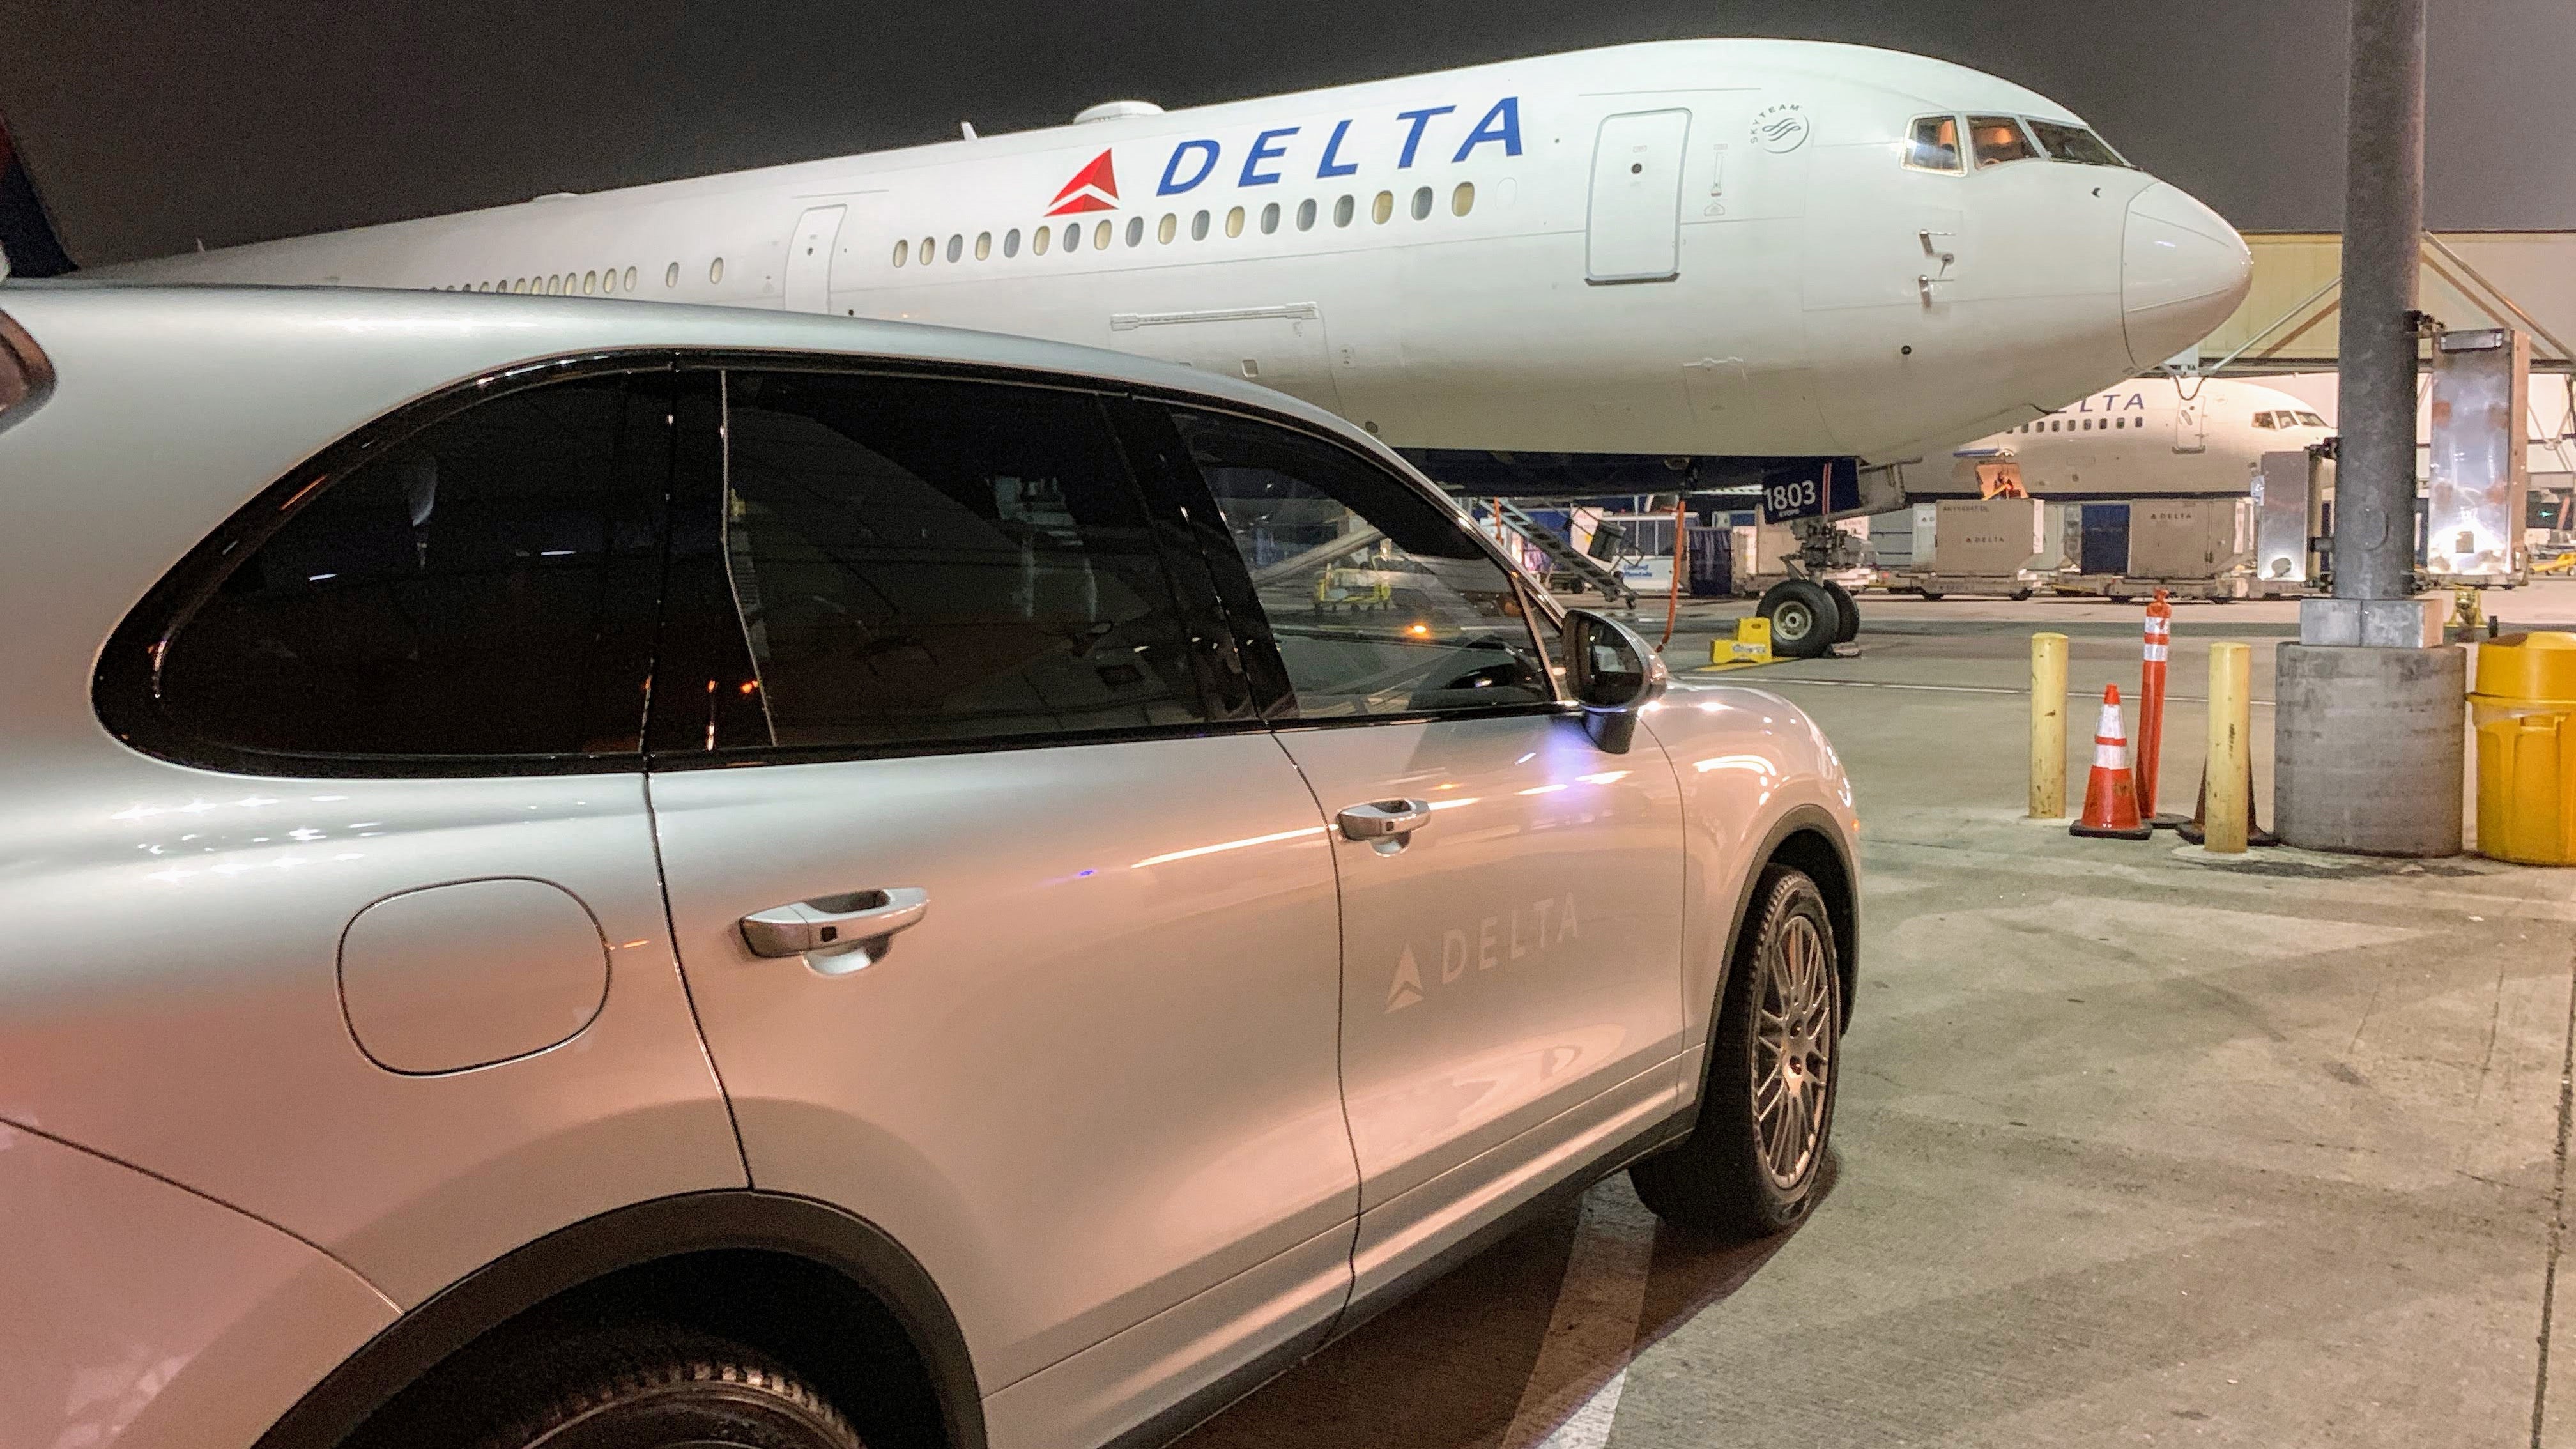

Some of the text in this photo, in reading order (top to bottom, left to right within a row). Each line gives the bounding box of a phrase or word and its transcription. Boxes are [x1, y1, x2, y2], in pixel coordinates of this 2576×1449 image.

[1750, 103, 1800, 144] SKYTEAM
[1156, 96, 1523, 197] DELTA
[2058, 393, 2145, 413] LTA
[1763, 480, 1816, 512] 1803
[1441, 891, 1579, 985] DELTA
